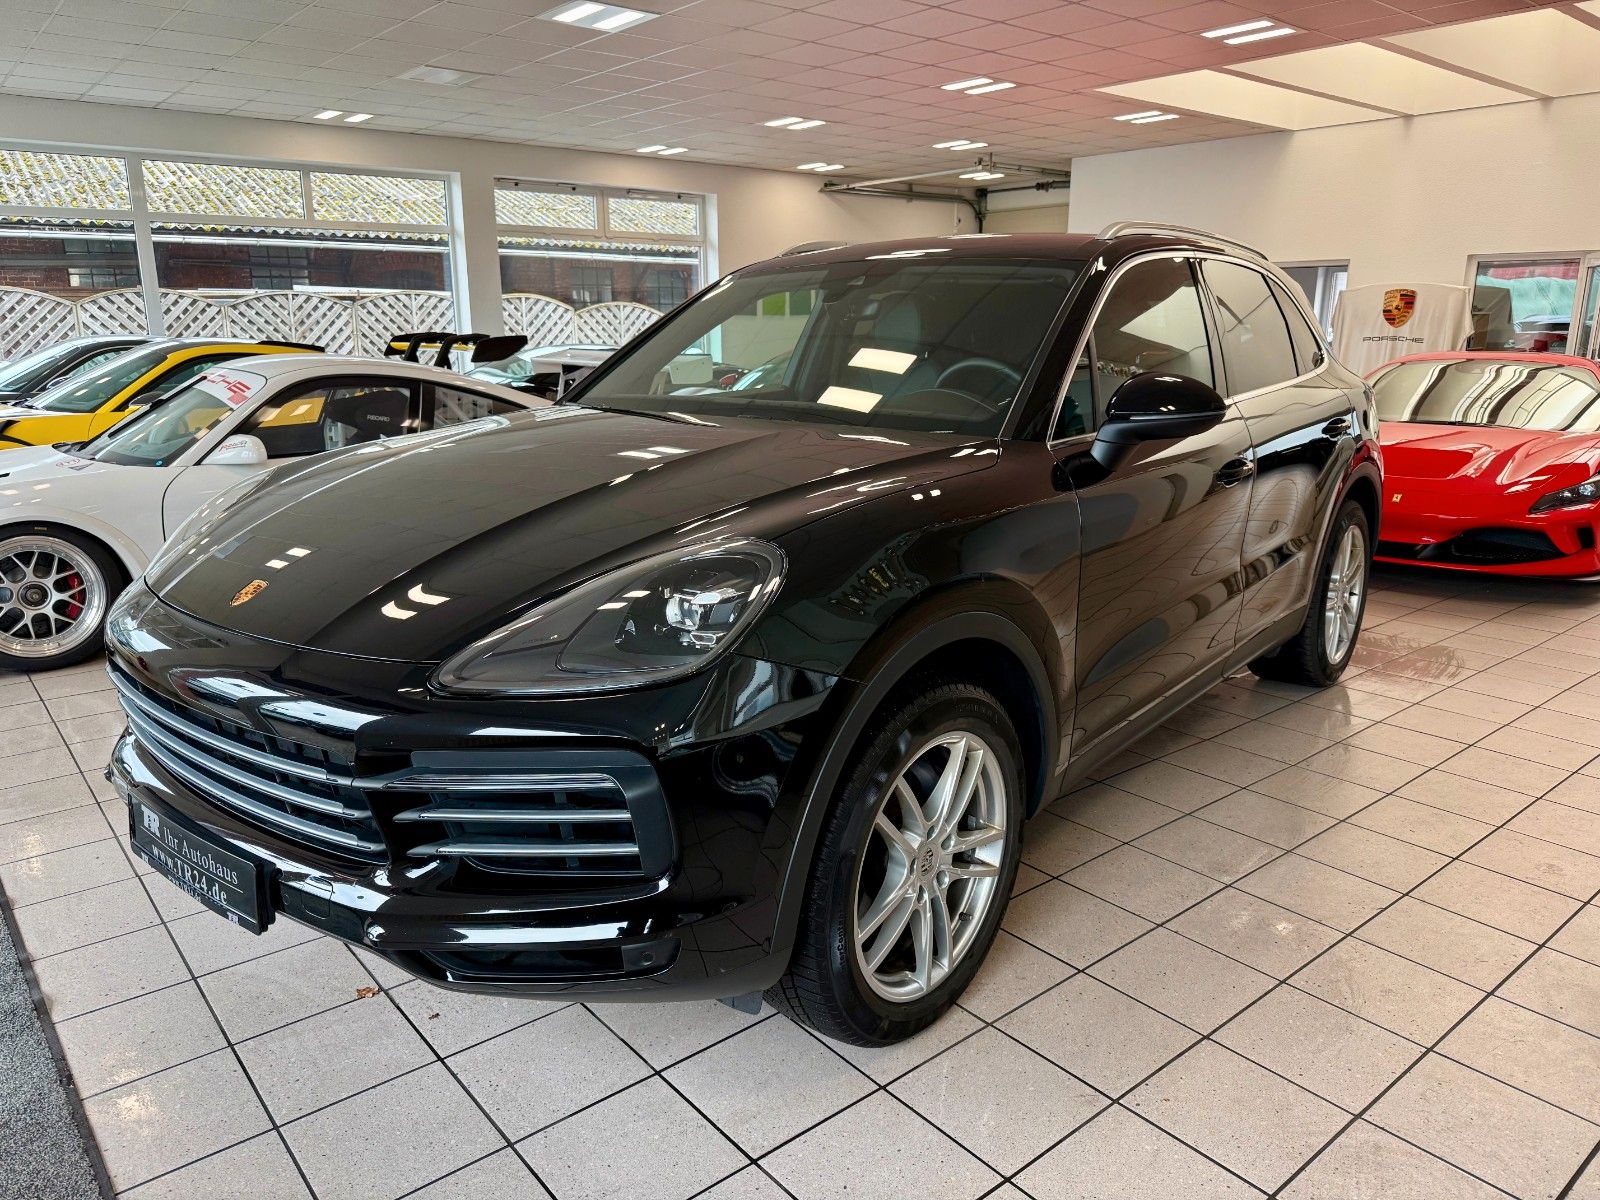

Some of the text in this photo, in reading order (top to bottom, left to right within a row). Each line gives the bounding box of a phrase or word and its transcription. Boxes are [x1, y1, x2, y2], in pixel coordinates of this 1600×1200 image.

[1363, 336, 1424, 344] PORSCHE
[151, 844, 227, 905] www.TR24.de
[163, 826, 238, 885] Ihr Autohaus
